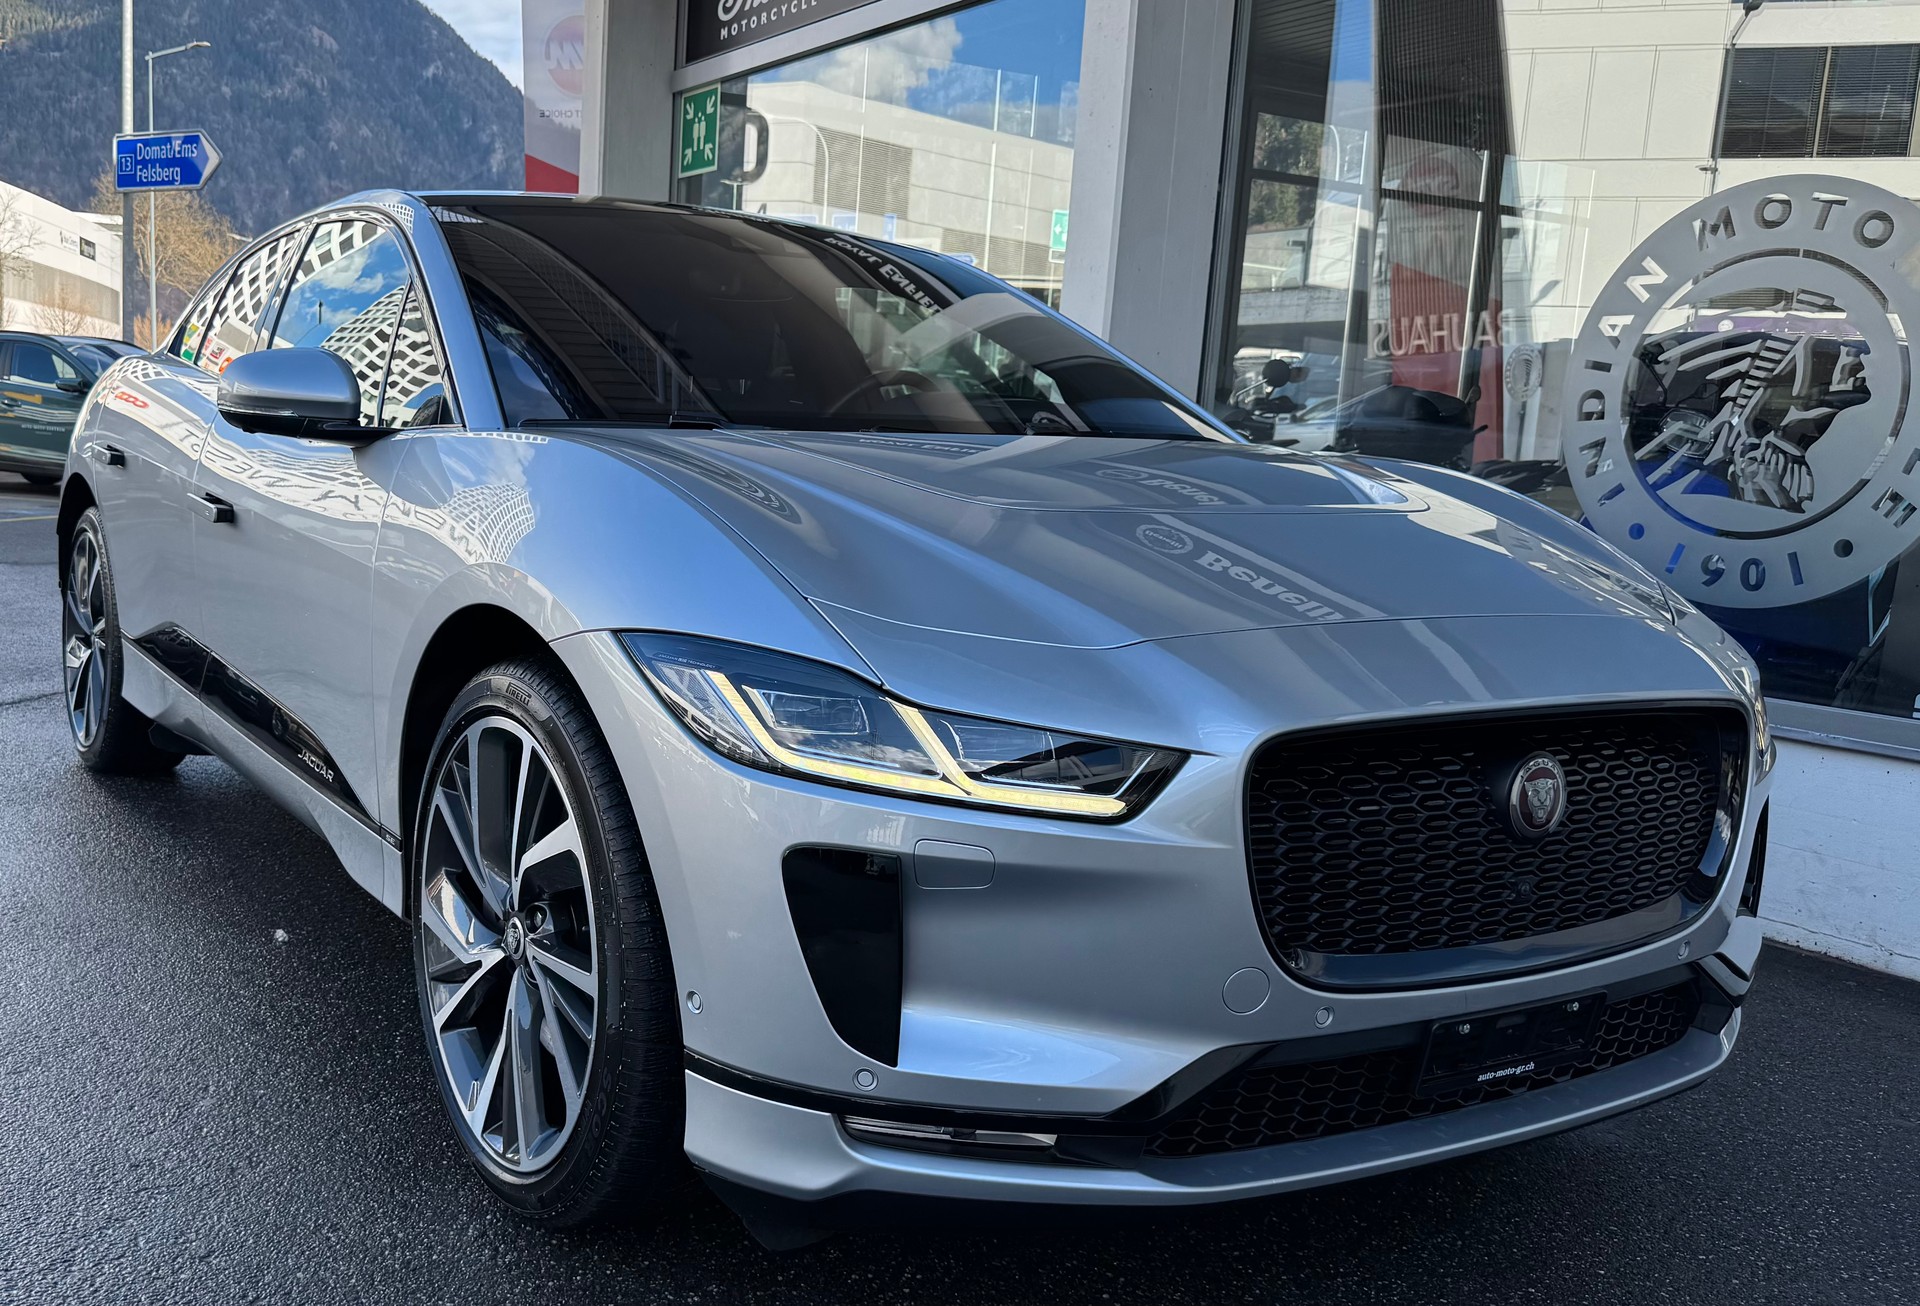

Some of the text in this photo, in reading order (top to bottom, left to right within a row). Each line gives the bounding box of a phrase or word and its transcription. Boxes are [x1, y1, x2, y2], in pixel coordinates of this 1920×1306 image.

[136, 140, 198, 160] Domat/Ems
[121, 156, 132, 172] 13
[136, 163, 181, 185] Felsberg
[1577, 256, 1669, 507] INDIAN
[1664, 542, 1804, 592] 1901
[505, 681, 532, 706] PIRELLI
[297, 749, 335, 783] JAGUAR
[1477, 1061, 1535, 1081] auto-moto-gr.ch
